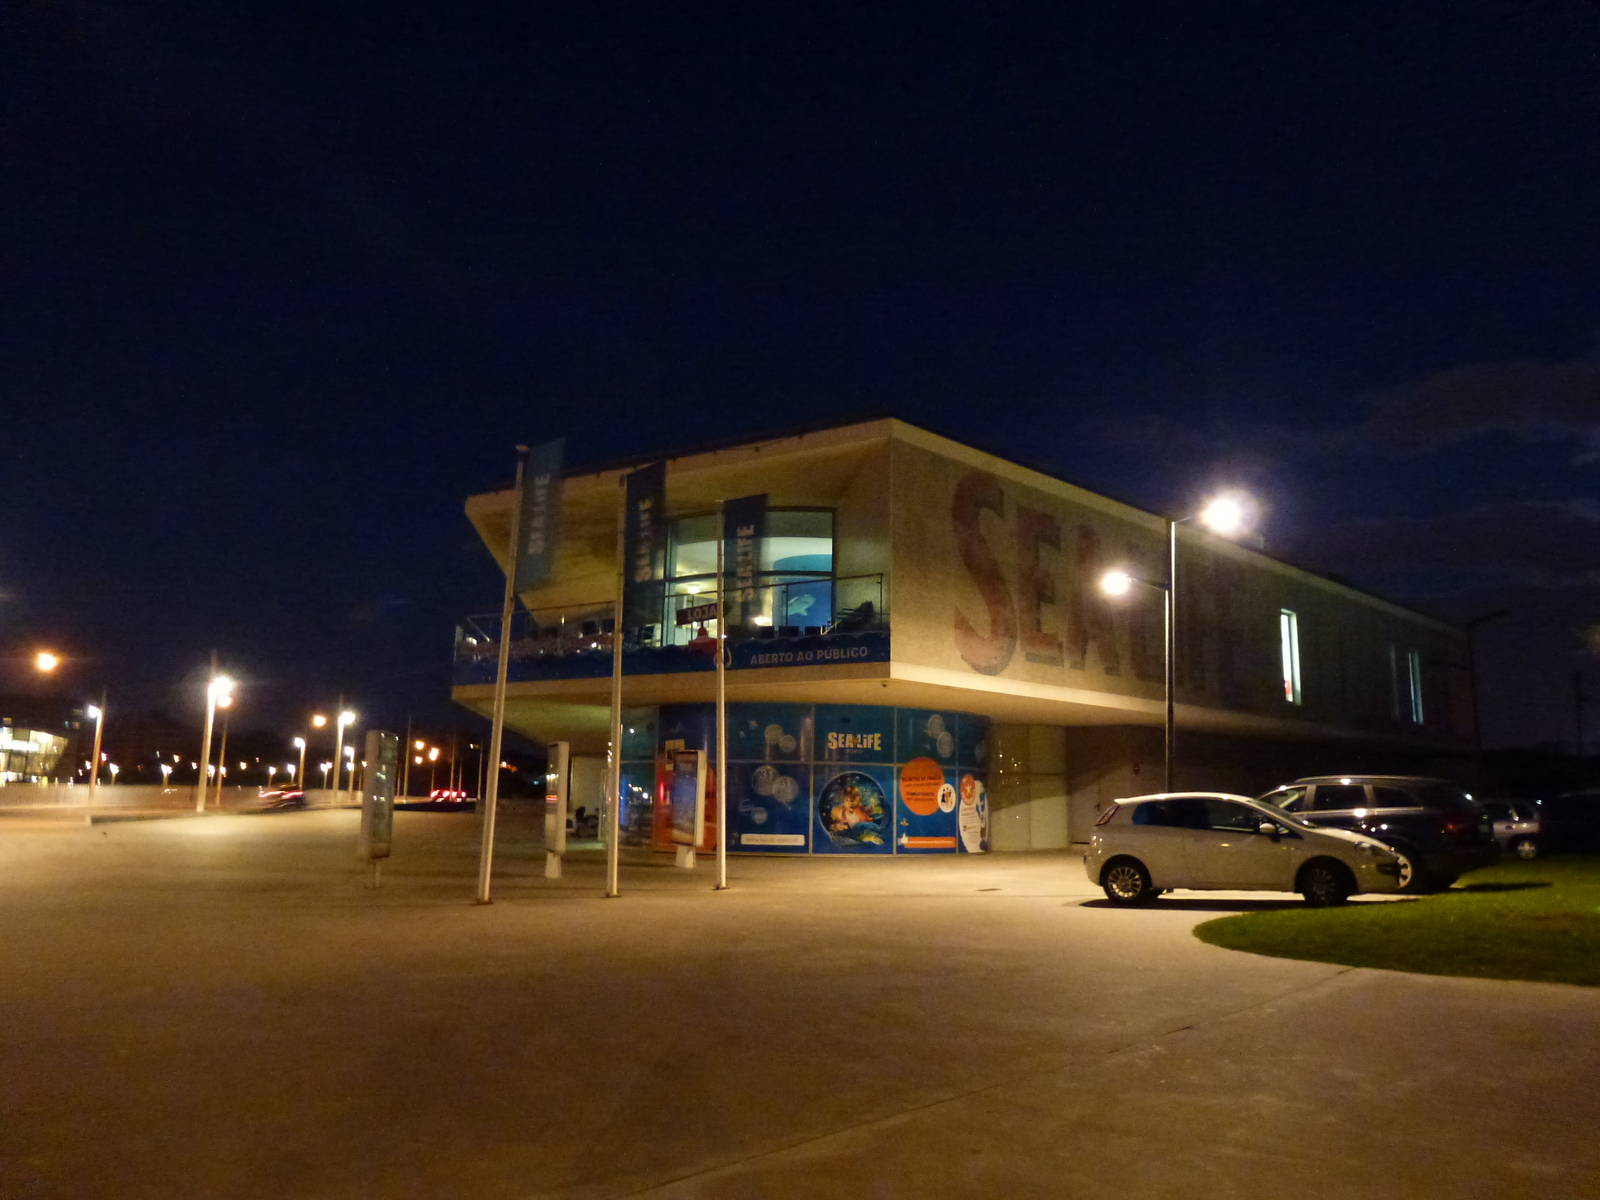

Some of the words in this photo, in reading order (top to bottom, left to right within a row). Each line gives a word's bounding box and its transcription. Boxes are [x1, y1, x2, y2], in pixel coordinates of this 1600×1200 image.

[687, 604, 717, 621] LOJA
[750, 652, 793, 665] ABERTO
[797, 650, 814, 662] AO
[816, 645, 868, 660] PÚBLICO
